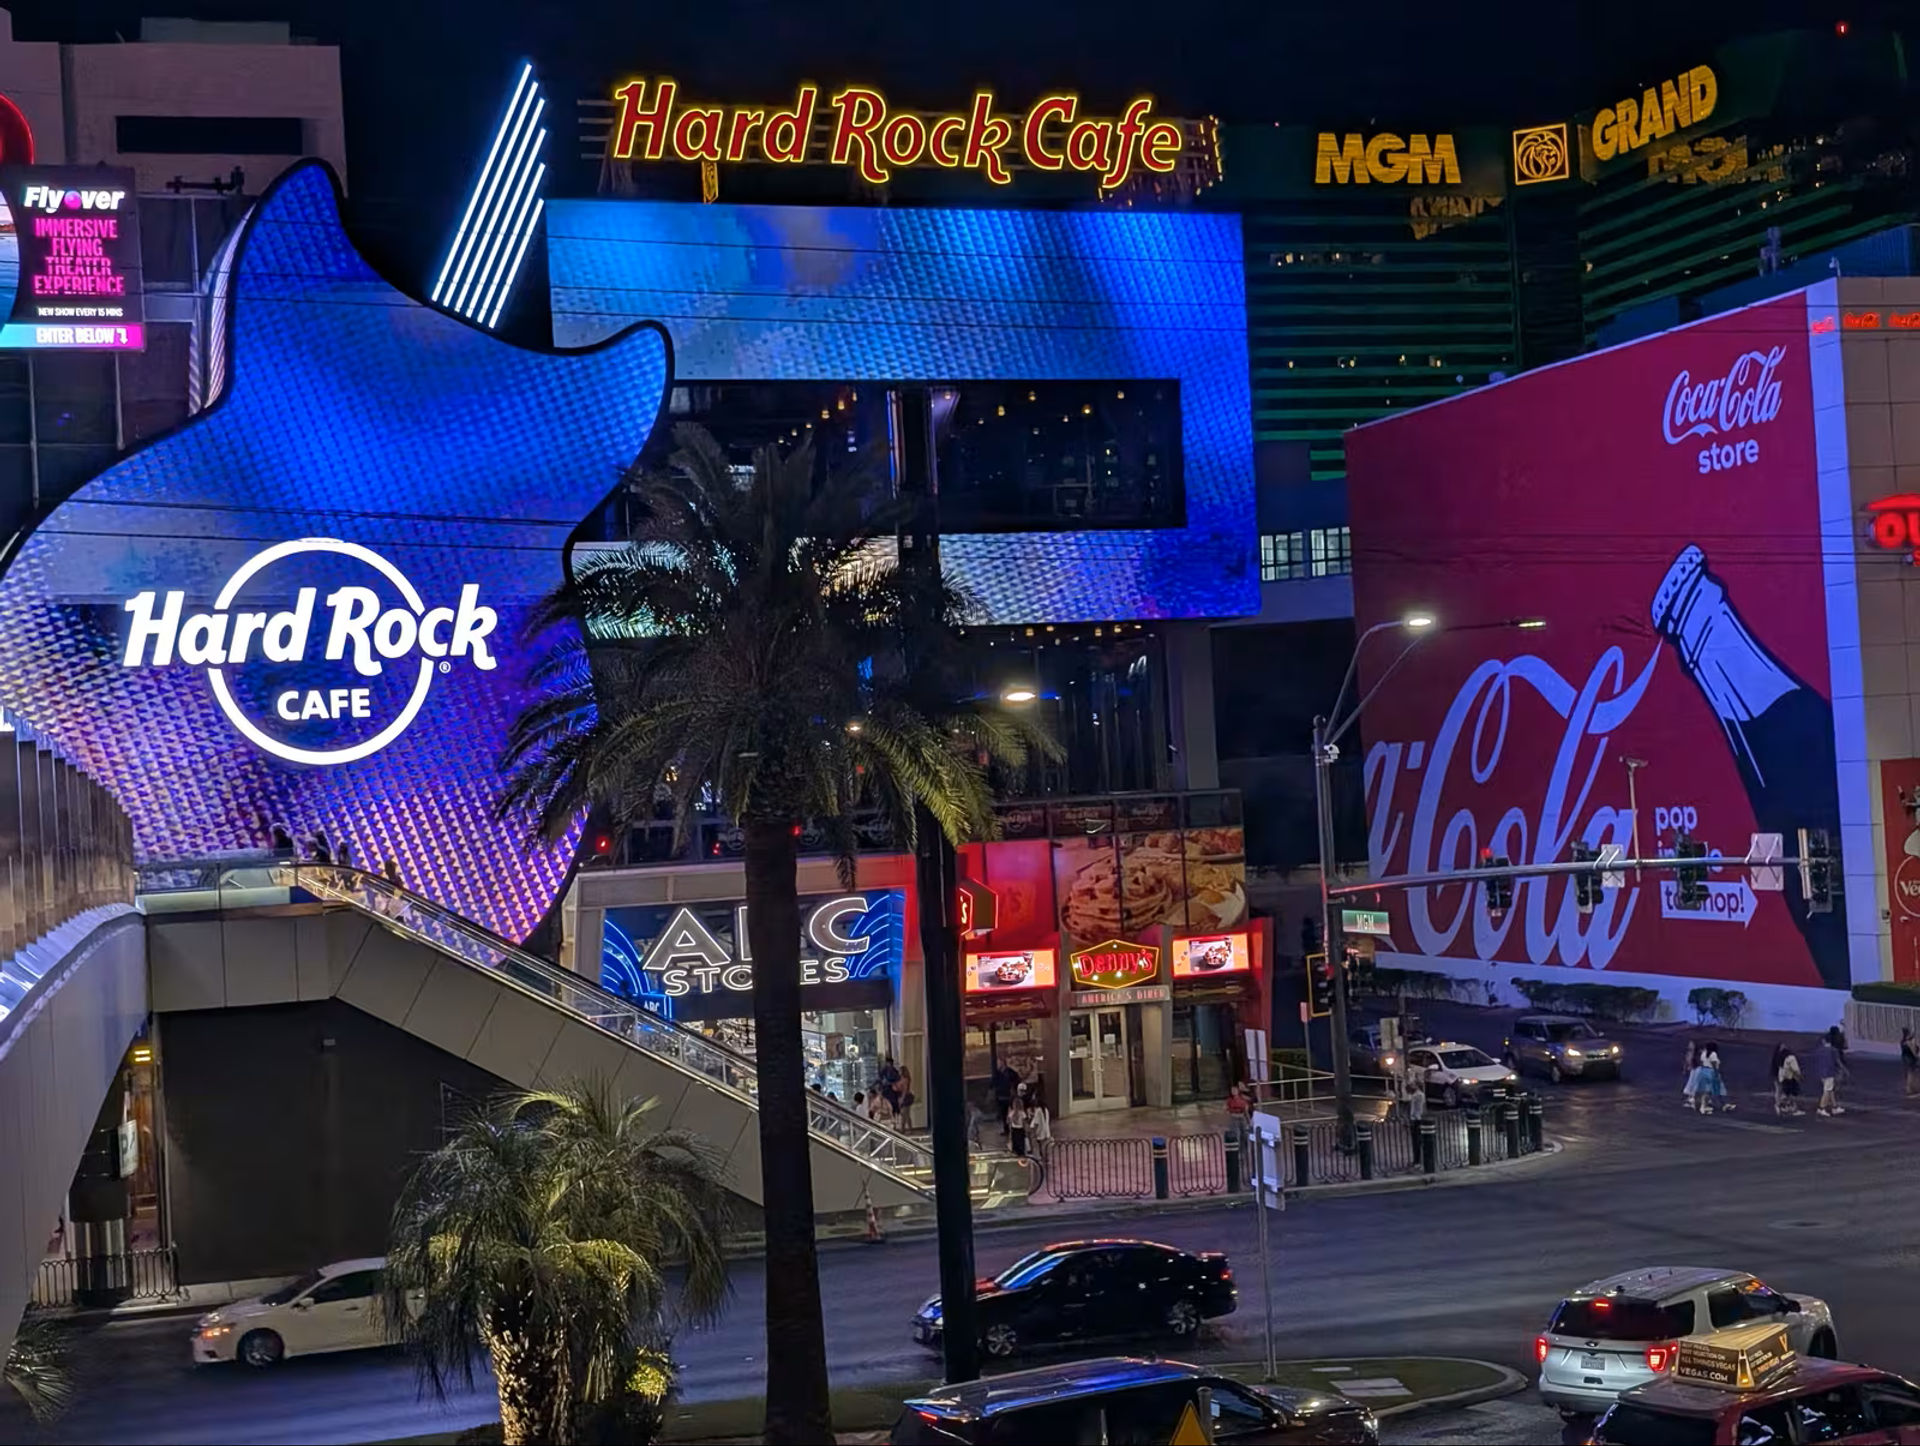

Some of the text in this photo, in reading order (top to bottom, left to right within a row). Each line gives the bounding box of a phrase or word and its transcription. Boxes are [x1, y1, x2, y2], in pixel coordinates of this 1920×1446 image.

[1592, 64, 1718, 161] GRAND
[613, 80, 1183, 189] Hard Rock Cafe
[1314, 132, 1462, 184] MGM
[34, 218, 118, 239] IMMERSIVE
[51, 237, 104, 257] FLYING
[45, 256, 112, 276] THEATER
[33, 275, 125, 295] EXPERIENCE
[75, 306, 97, 317] EVERY
[36, 327, 115, 344] ENTER BELOW
[1662, 345, 1787, 445] Coca-Cola
[1698, 439, 1759, 474] store
[122, 583, 498, 676] Hard Rock
[276, 688, 371, 721] CAFE
[1655, 806, 1698, 836] pop
[642, 897, 870, 971] AC
[662, 956, 850, 996] STOES
[1076, 948, 1154, 978] Denny's
